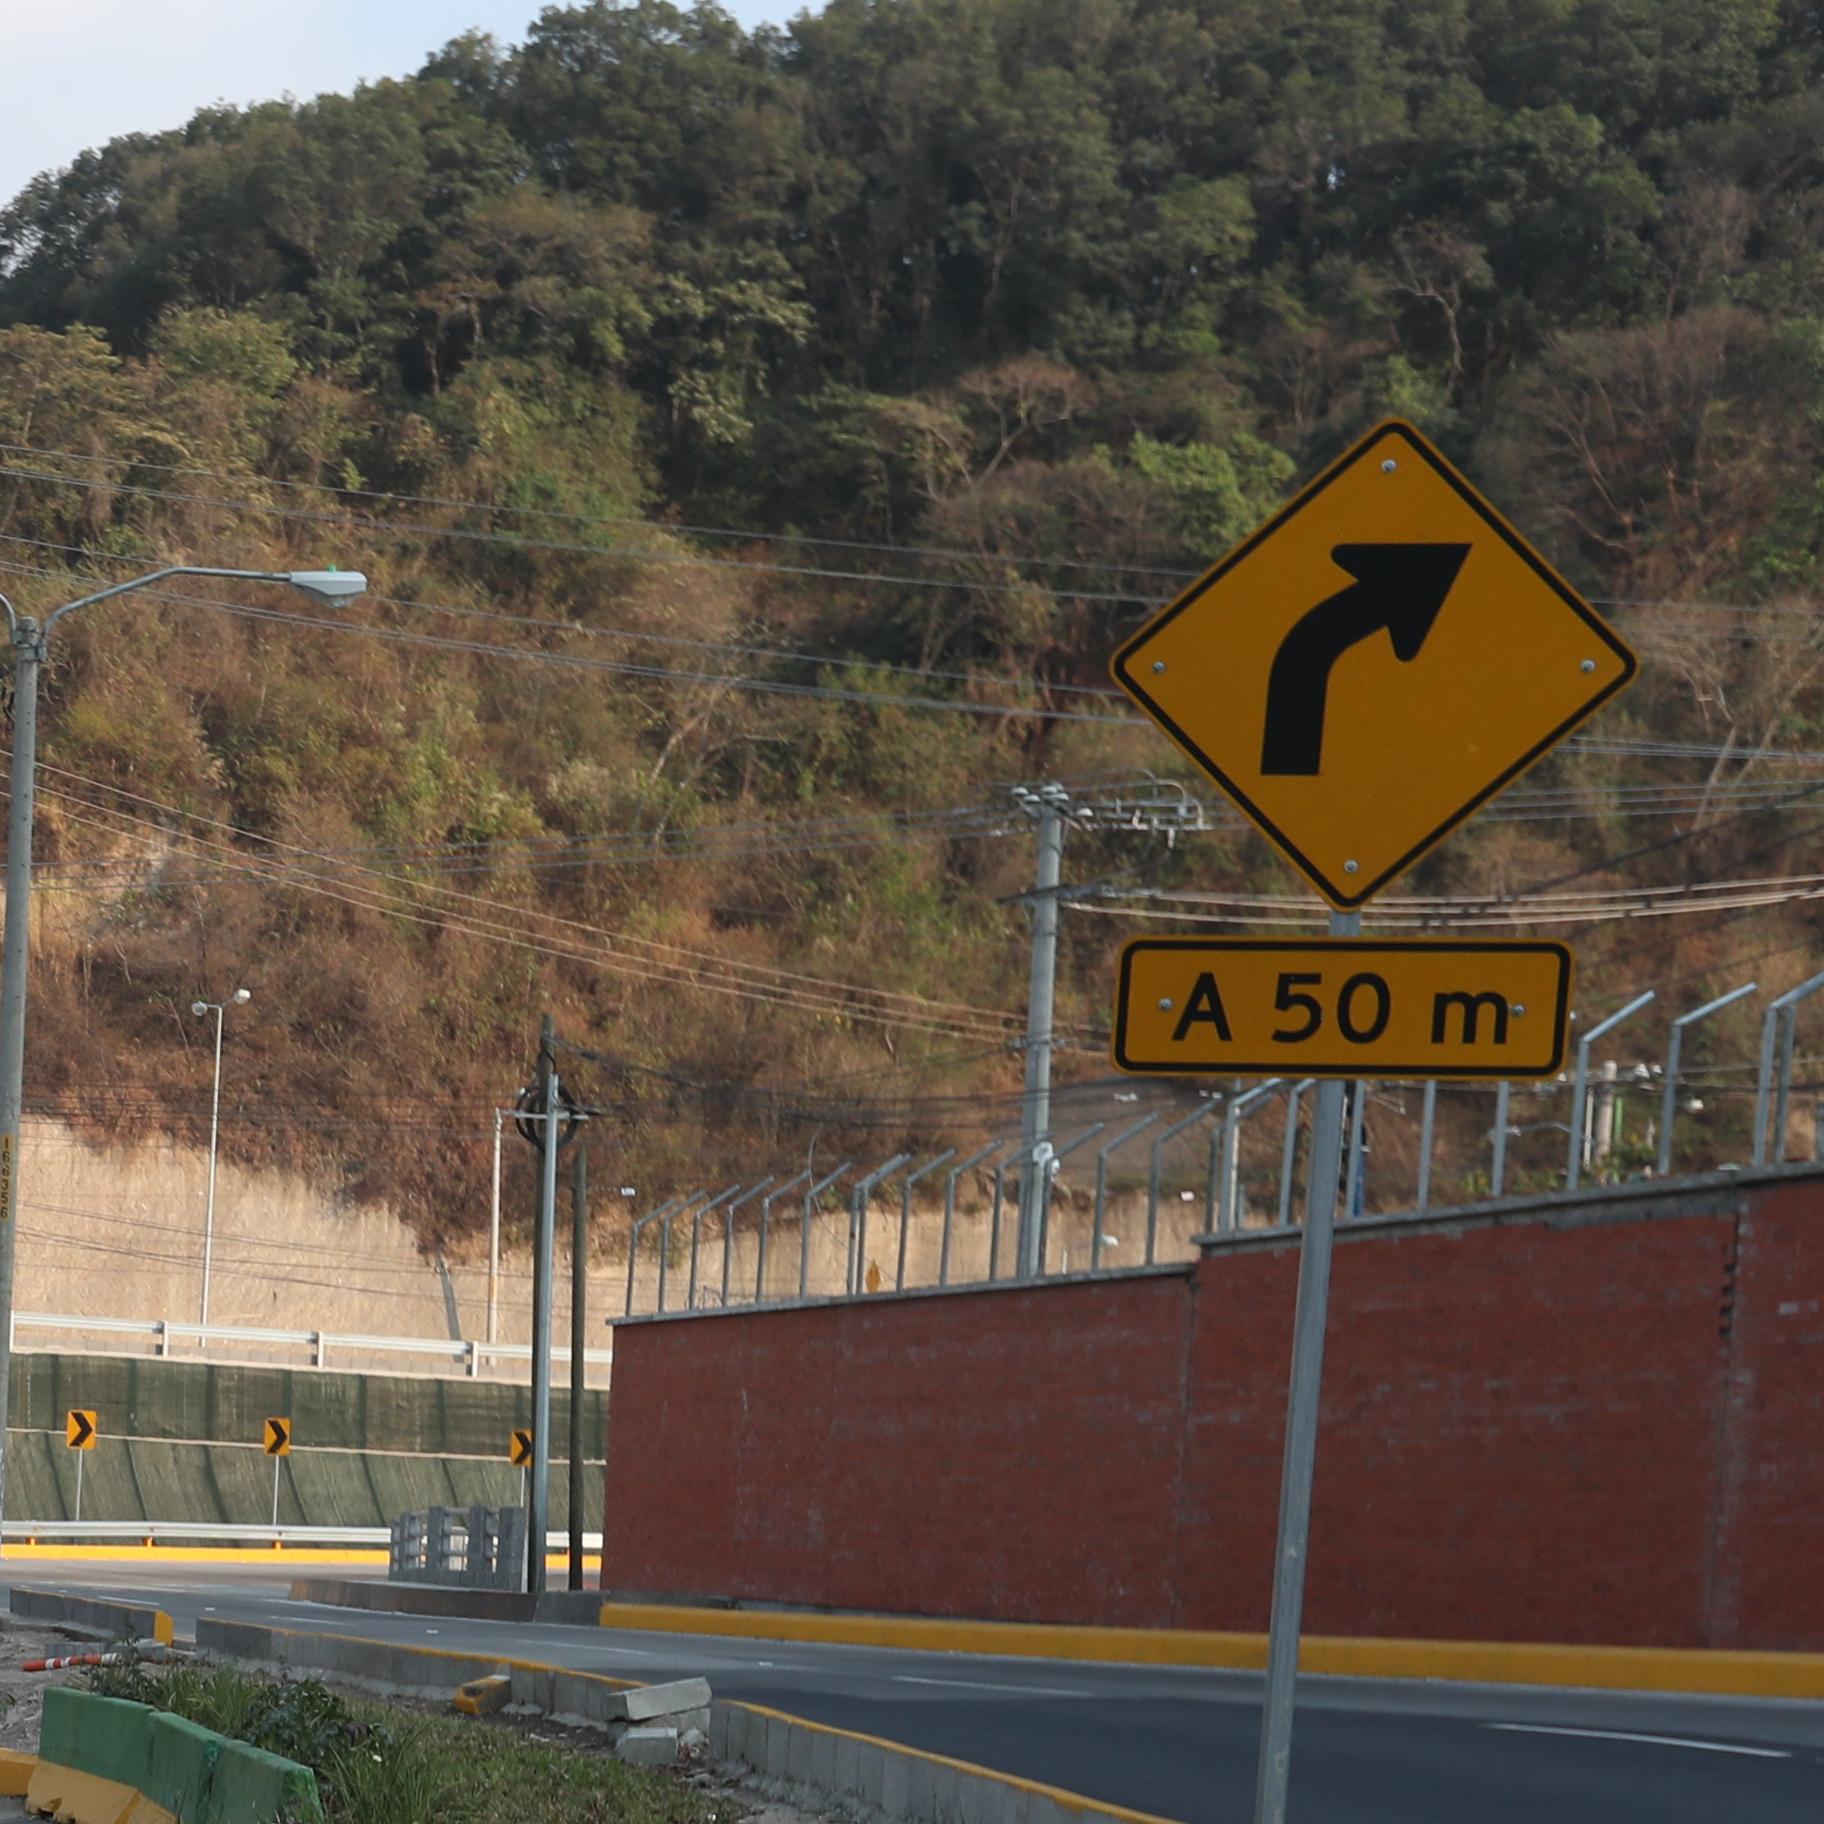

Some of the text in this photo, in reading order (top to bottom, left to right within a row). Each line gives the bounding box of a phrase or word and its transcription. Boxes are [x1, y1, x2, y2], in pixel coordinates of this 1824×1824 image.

[1171, 971, 1509, 1045] A 50 m
